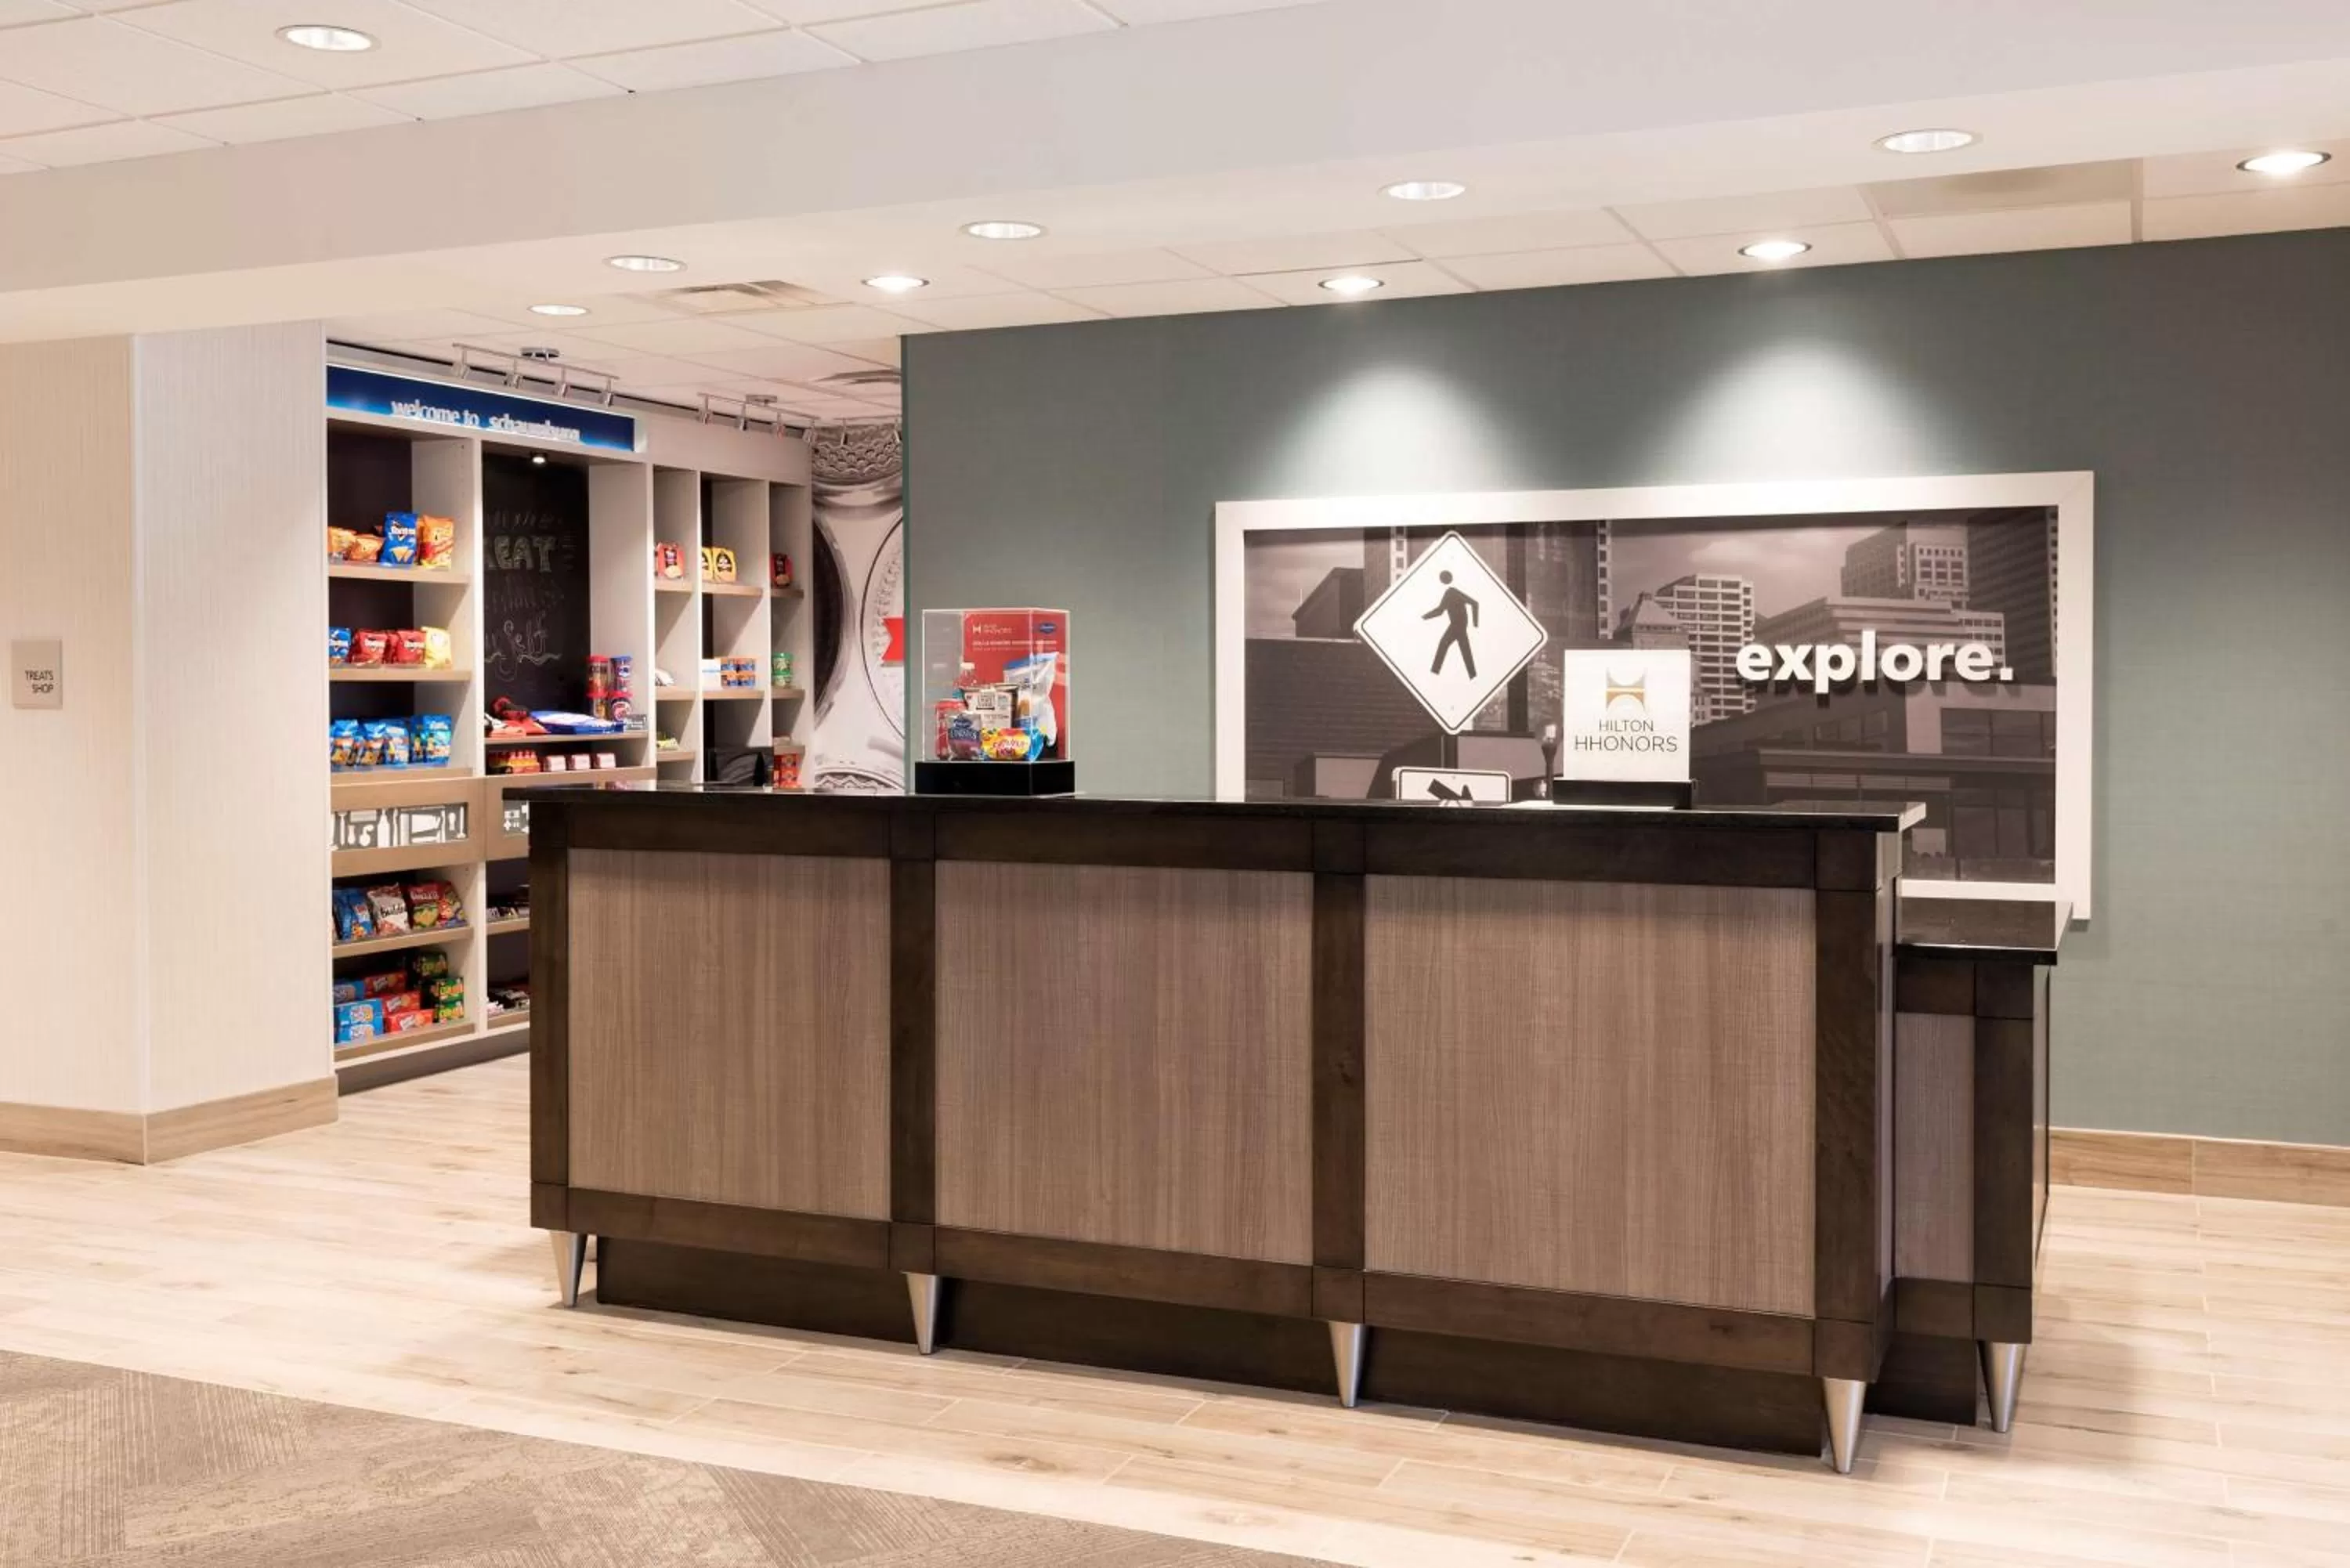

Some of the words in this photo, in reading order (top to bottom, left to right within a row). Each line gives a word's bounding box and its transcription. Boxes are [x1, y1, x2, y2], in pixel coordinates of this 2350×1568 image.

[391, 399, 460, 425] welcome
[463, 410, 480, 427] to
[1735, 628, 2014, 694] explore.
[24, 670, 54, 681] TREATS
[32, 684, 54, 693] SHOP
[1599, 720, 1654, 732] HILTON
[1574, 735, 1678, 753] HHONORS
